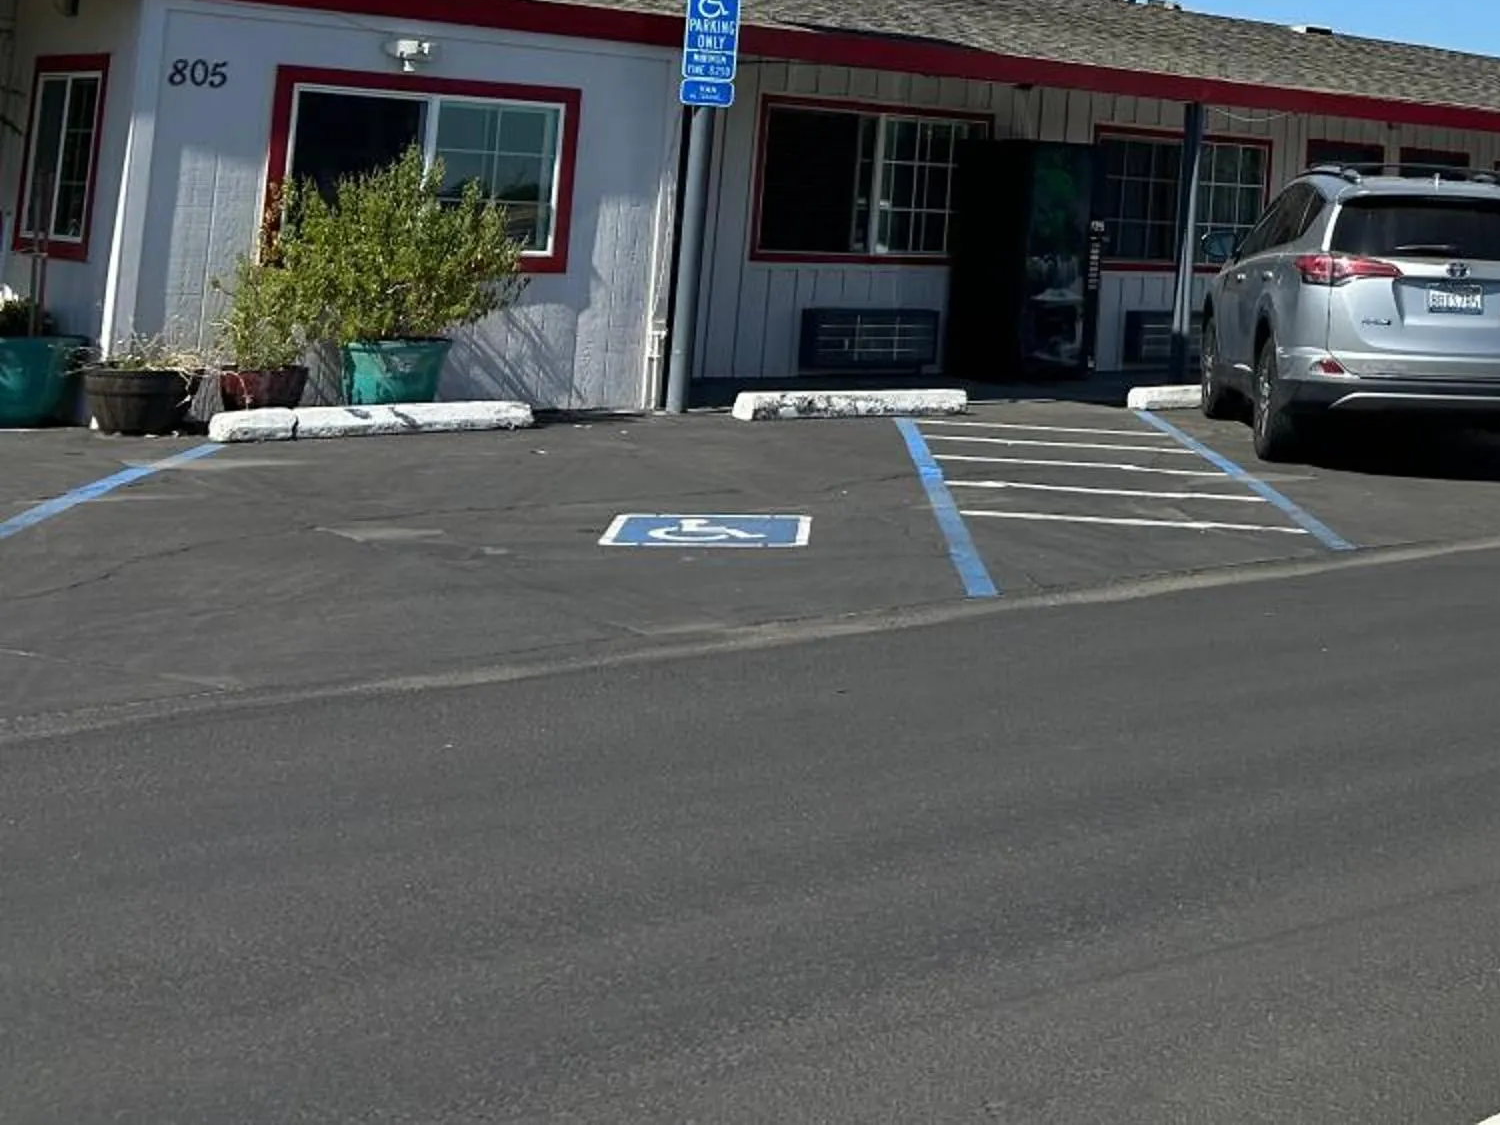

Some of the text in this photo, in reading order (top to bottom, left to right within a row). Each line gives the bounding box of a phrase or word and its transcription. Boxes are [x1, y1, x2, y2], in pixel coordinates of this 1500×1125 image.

[689, 18, 735, 35] PARKING
[697, 34, 726, 49] ONLY
[168, 59, 227, 88] 805
